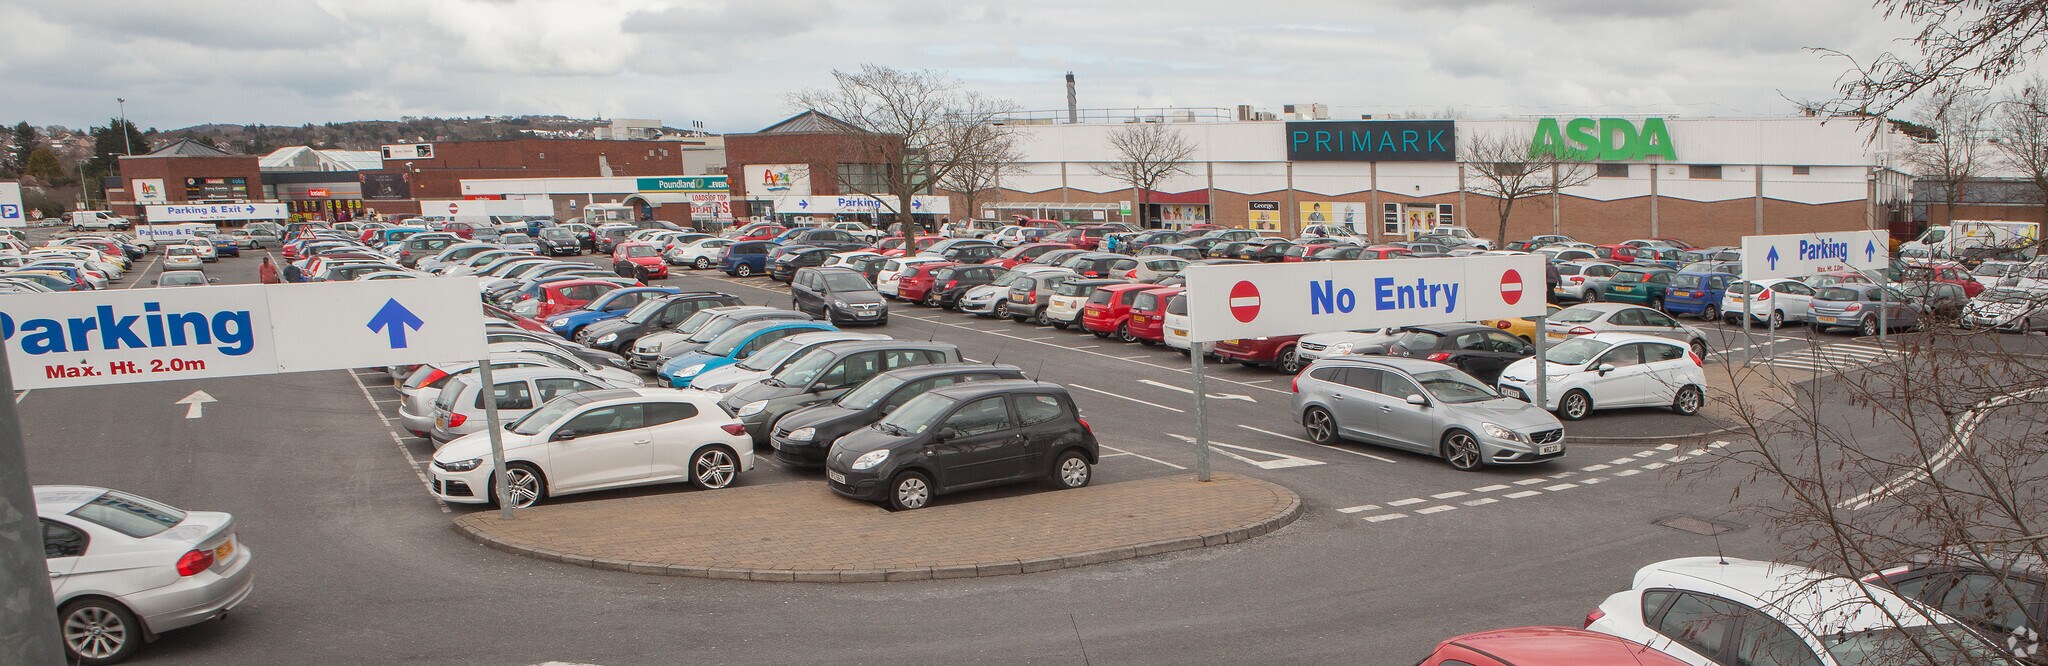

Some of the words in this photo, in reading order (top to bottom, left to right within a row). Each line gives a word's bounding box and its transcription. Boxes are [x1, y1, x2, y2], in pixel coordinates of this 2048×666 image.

[1293, 130, 1446, 152] PRIMARK
[1528, 117, 1677, 161] ASDA
[659, 180, 695, 189] Poundland
[167, 206, 207, 215] Parking
[221, 205, 241, 213] Exit
[838, 197, 881, 208] Parking
[1800, 238, 1847, 262] Parking
[1310, 280, 1355, 315] No
[1374, 277, 1459, 314] Entry
[45, 364, 102, 379] Max.
[109, 360, 143, 375] Ht.
[150, 358, 206, 373] 2.0m
